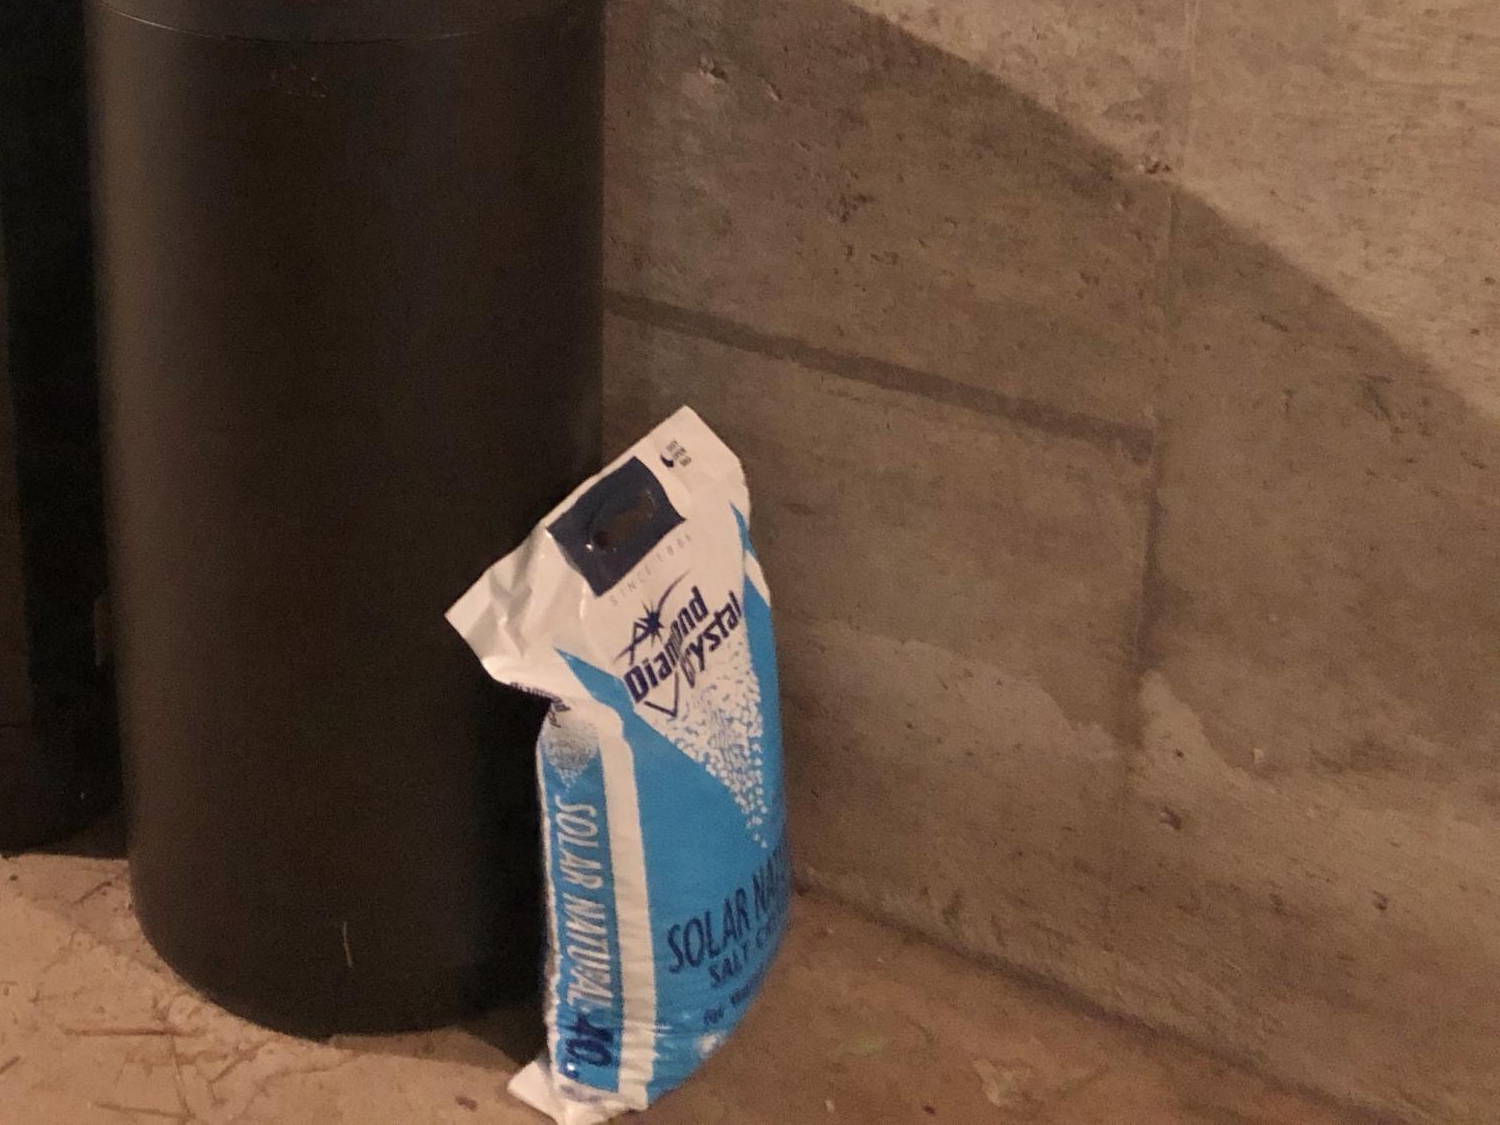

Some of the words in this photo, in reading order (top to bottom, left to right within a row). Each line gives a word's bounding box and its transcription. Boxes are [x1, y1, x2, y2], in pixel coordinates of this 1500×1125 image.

[623, 585, 709, 704] Diamond
[680, 590, 742, 689] Crystal
[554, 794, 604, 889] SOLAR
[667, 886, 750, 974] SOLAR
